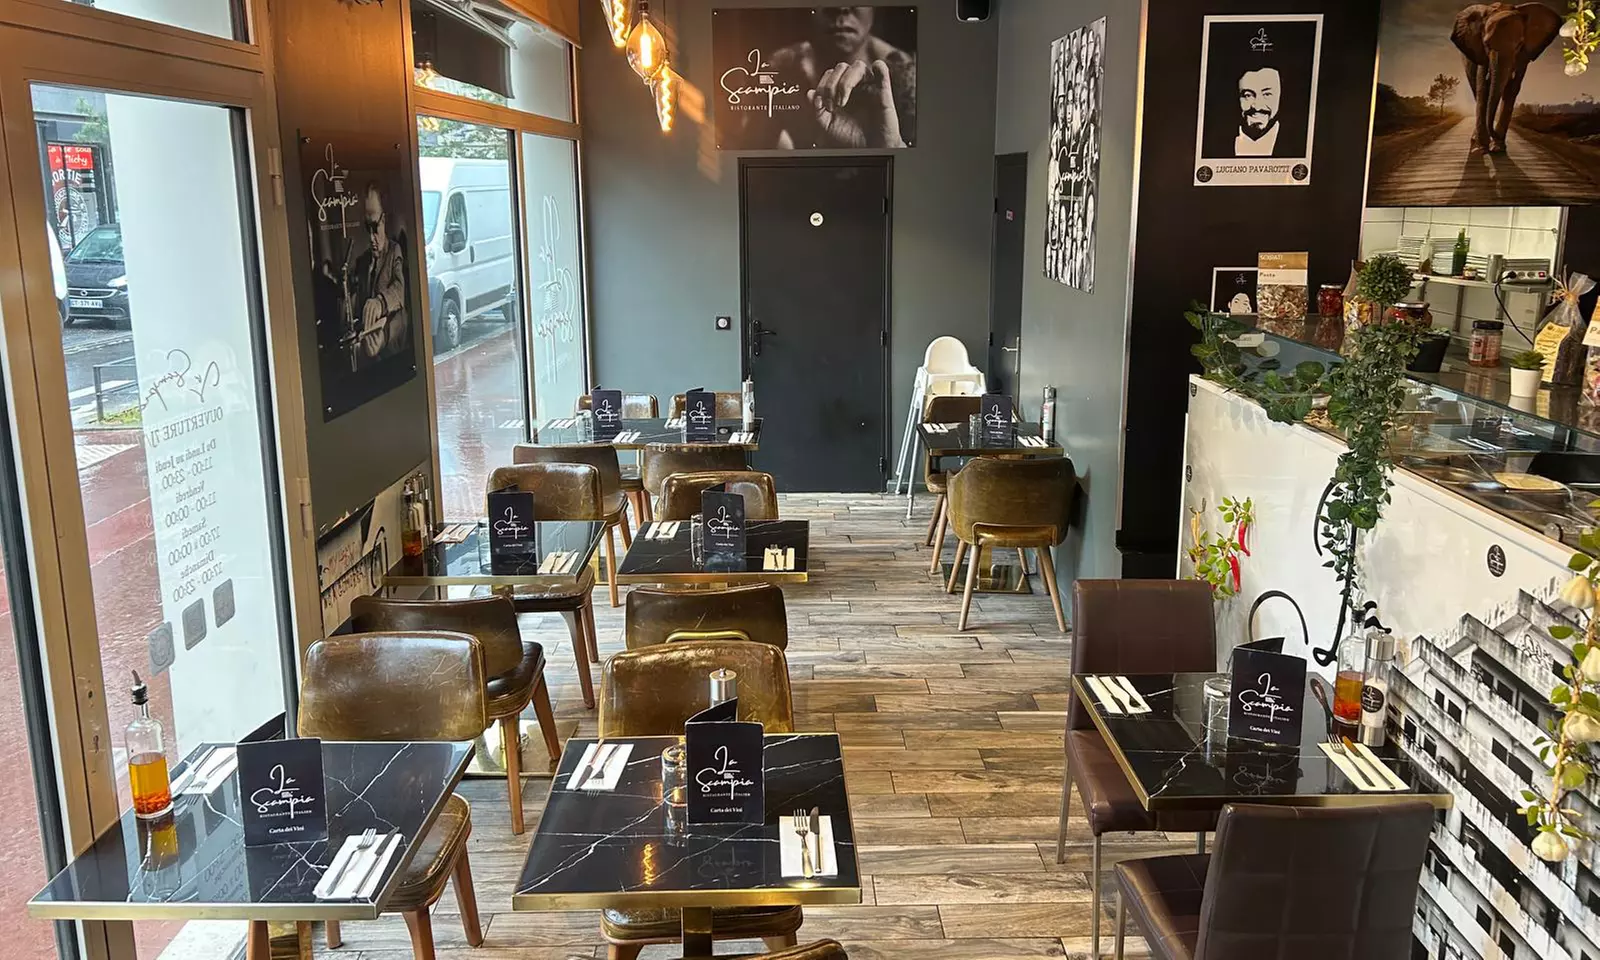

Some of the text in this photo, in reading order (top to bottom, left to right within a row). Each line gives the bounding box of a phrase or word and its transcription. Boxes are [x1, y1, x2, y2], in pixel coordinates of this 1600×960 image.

[747, 48, 776, 77] La
[720, 66, 800, 118] Scampia
[325, 143, 347, 182] La
[1215, 165, 1247, 174] LUCIANO
[1249, 165, 1290, 173] PAVAROTTI
[311, 168, 359, 239] Scampia
[504, 506, 519, 525] La
[717, 506, 732, 523] La
[1257, 672, 1281, 698] La
[1238, 689, 1294, 722] Scampia
[714, 745, 740, 775] La
[269, 764, 299, 794] La
[695, 767, 755, 800] Scampia
[250, 787, 316, 819] Scampia
